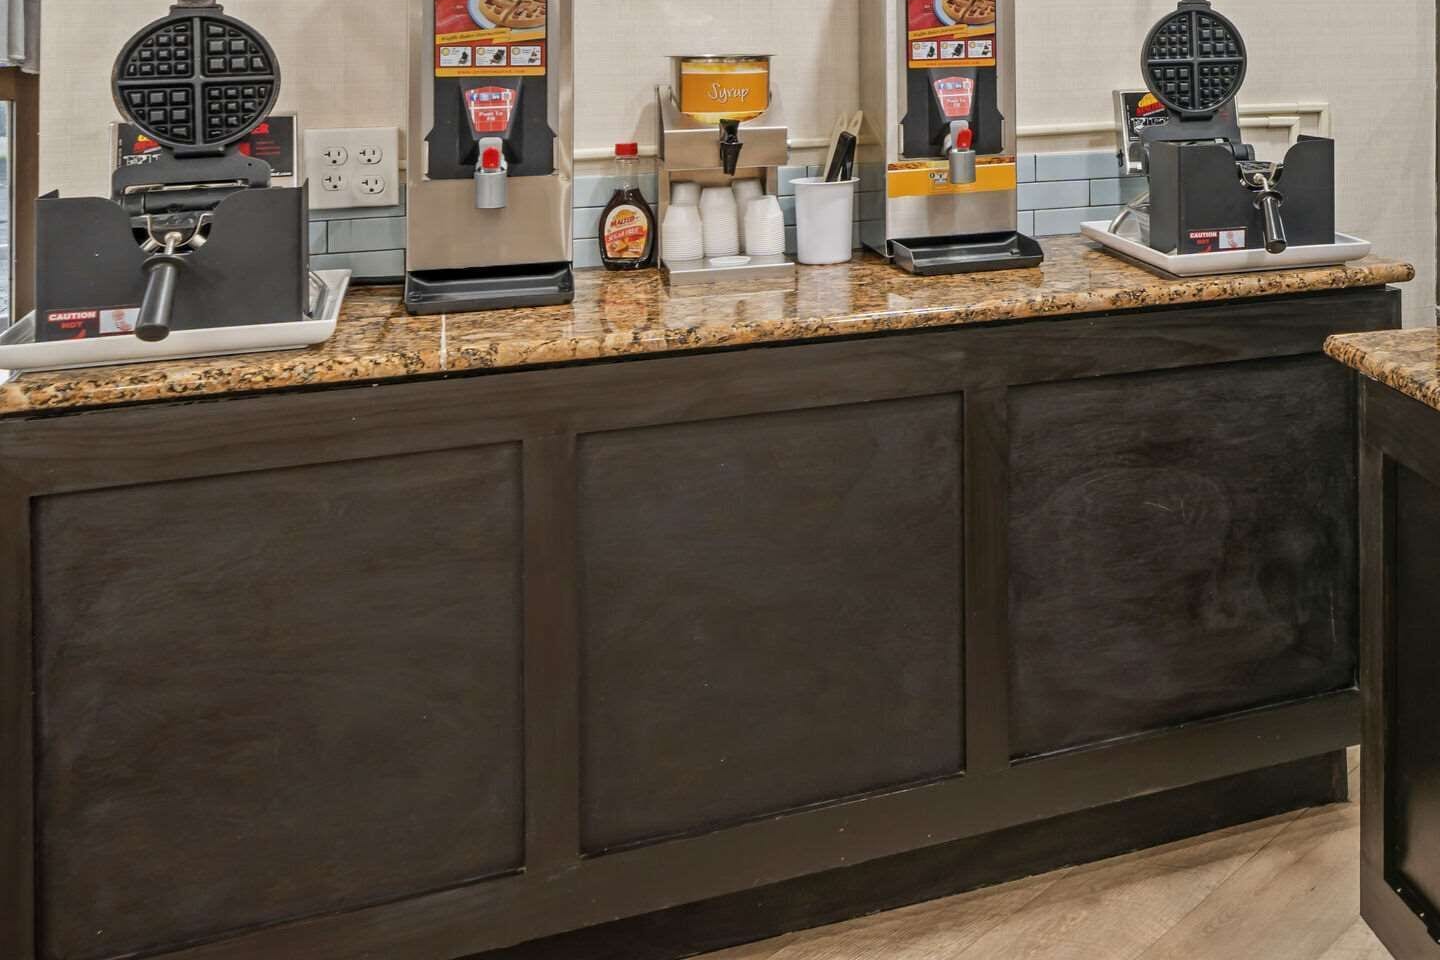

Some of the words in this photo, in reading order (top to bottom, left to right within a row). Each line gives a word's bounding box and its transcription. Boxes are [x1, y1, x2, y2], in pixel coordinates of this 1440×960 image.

[708, 82, 749, 103] Syrup
[1189, 231, 1218, 239] CAUTION
[48, 310, 97, 321] CAUTION
[61, 321, 83, 329] HOT
